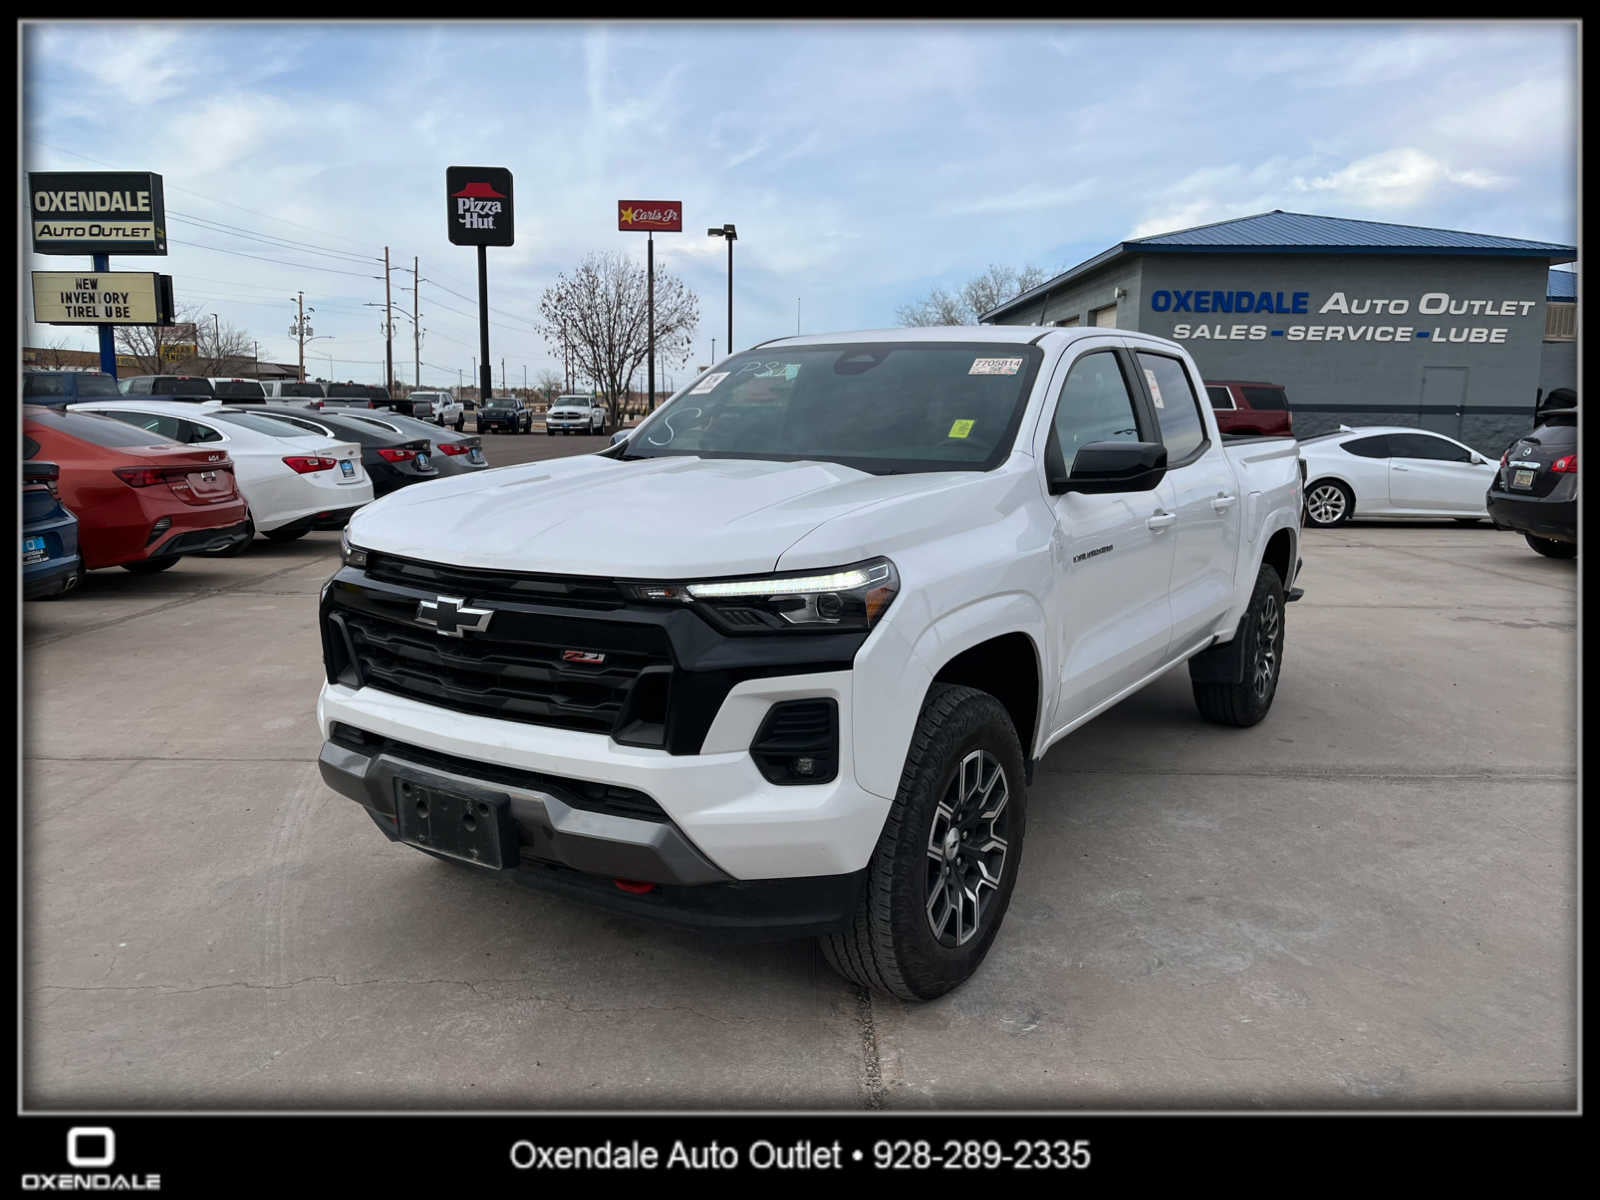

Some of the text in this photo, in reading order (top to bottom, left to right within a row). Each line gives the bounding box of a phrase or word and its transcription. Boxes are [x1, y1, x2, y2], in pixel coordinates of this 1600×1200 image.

[34, 191, 150, 212] OXENDALE
[457, 197, 502, 215] Pizza
[458, 212, 496, 229] Hut
[75, 278, 98, 290] NEW
[1151, 289, 1310, 315] OXENDALE
